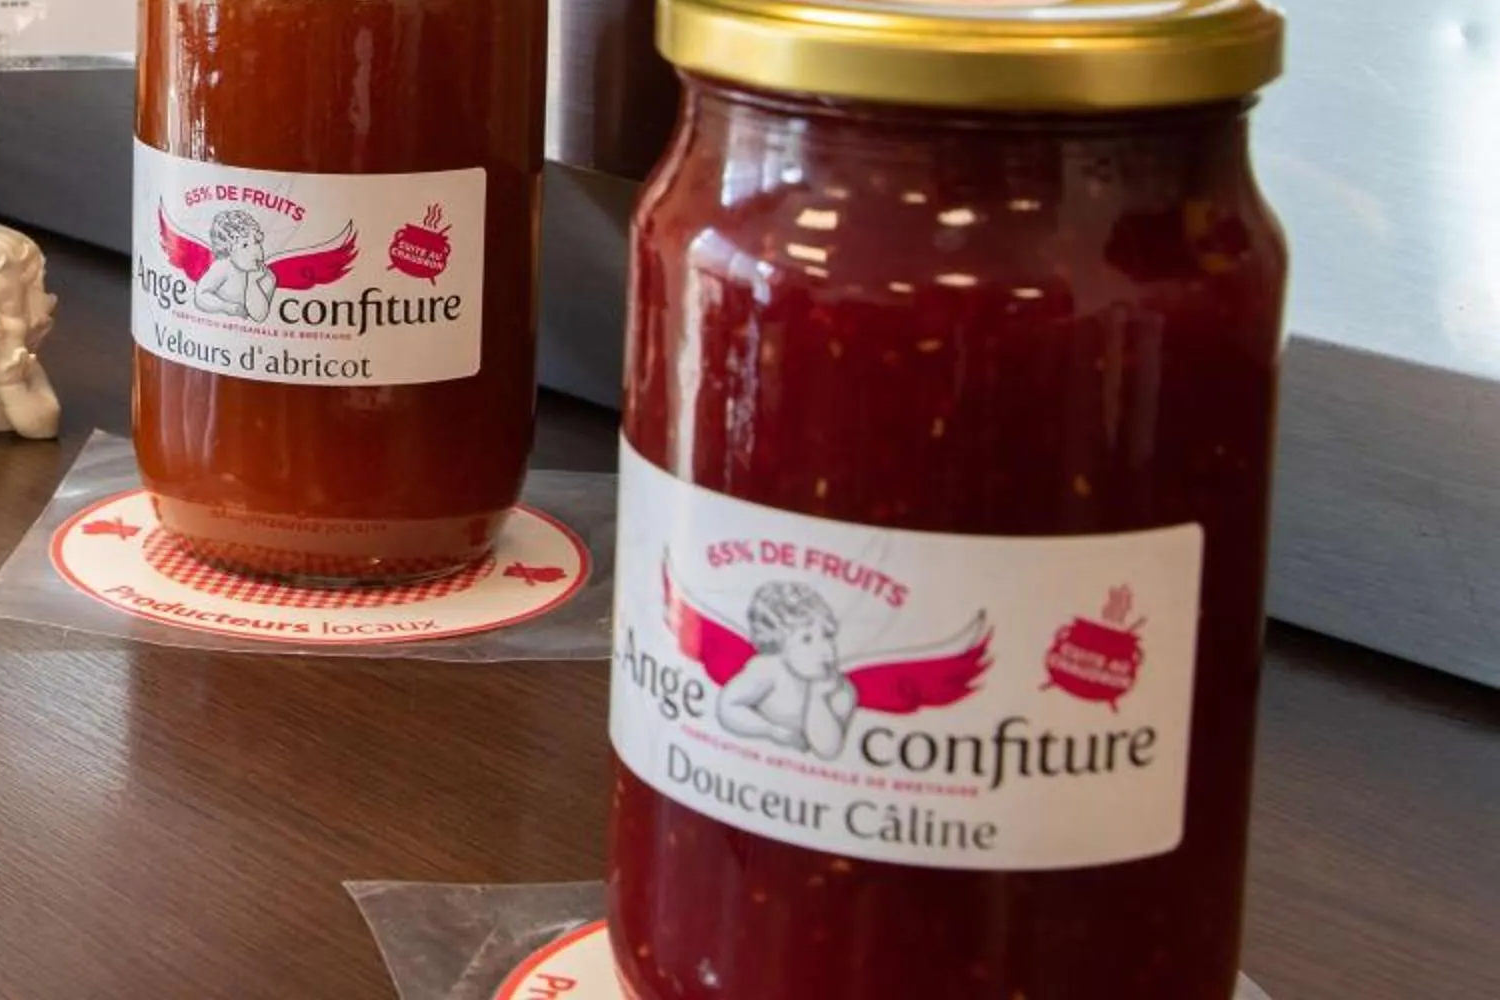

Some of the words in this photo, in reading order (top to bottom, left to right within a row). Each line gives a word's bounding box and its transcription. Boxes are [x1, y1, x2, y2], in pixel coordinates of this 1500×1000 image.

[215, 185, 238, 201] DE
[241, 187, 307, 222] FRUITS
[278, 286, 462, 336] confiture
[152, 322, 231, 368] Velours
[239, 345, 373, 379] d'abricot
[706, 539, 755, 569] 65%
[759, 539, 798, 568] DE
[803, 547, 911, 609] FRUITS
[103, 584, 310, 634] Producteurs
[321, 618, 440, 636] locaux
[859, 715, 1158, 790] confiture
[666, 741, 832, 831] Douceur
[843, 799, 999, 851] Câline
